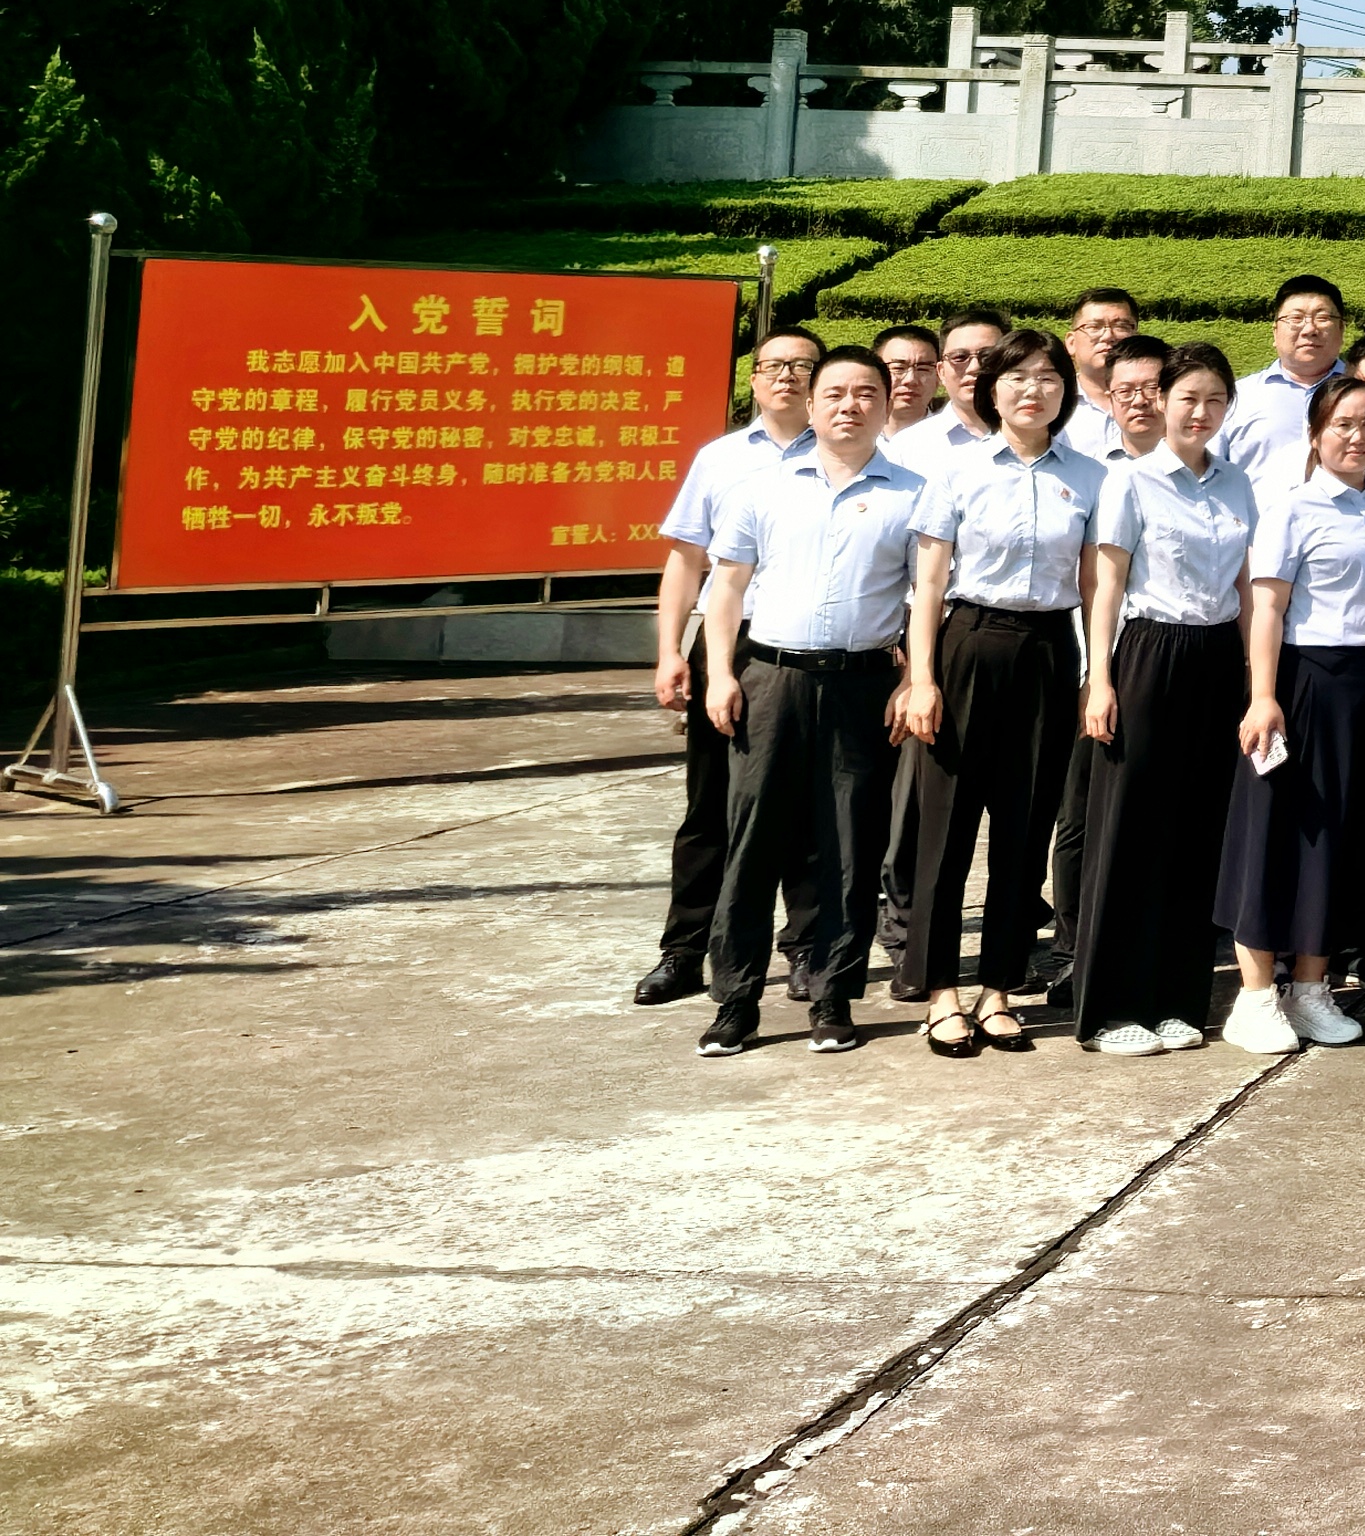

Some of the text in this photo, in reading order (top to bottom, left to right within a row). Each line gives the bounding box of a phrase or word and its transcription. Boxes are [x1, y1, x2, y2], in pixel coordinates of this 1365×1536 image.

[348, 293, 566, 338] 入党誓词
[181, 502, 412, 531] 牺牲一切，永不叛党。
